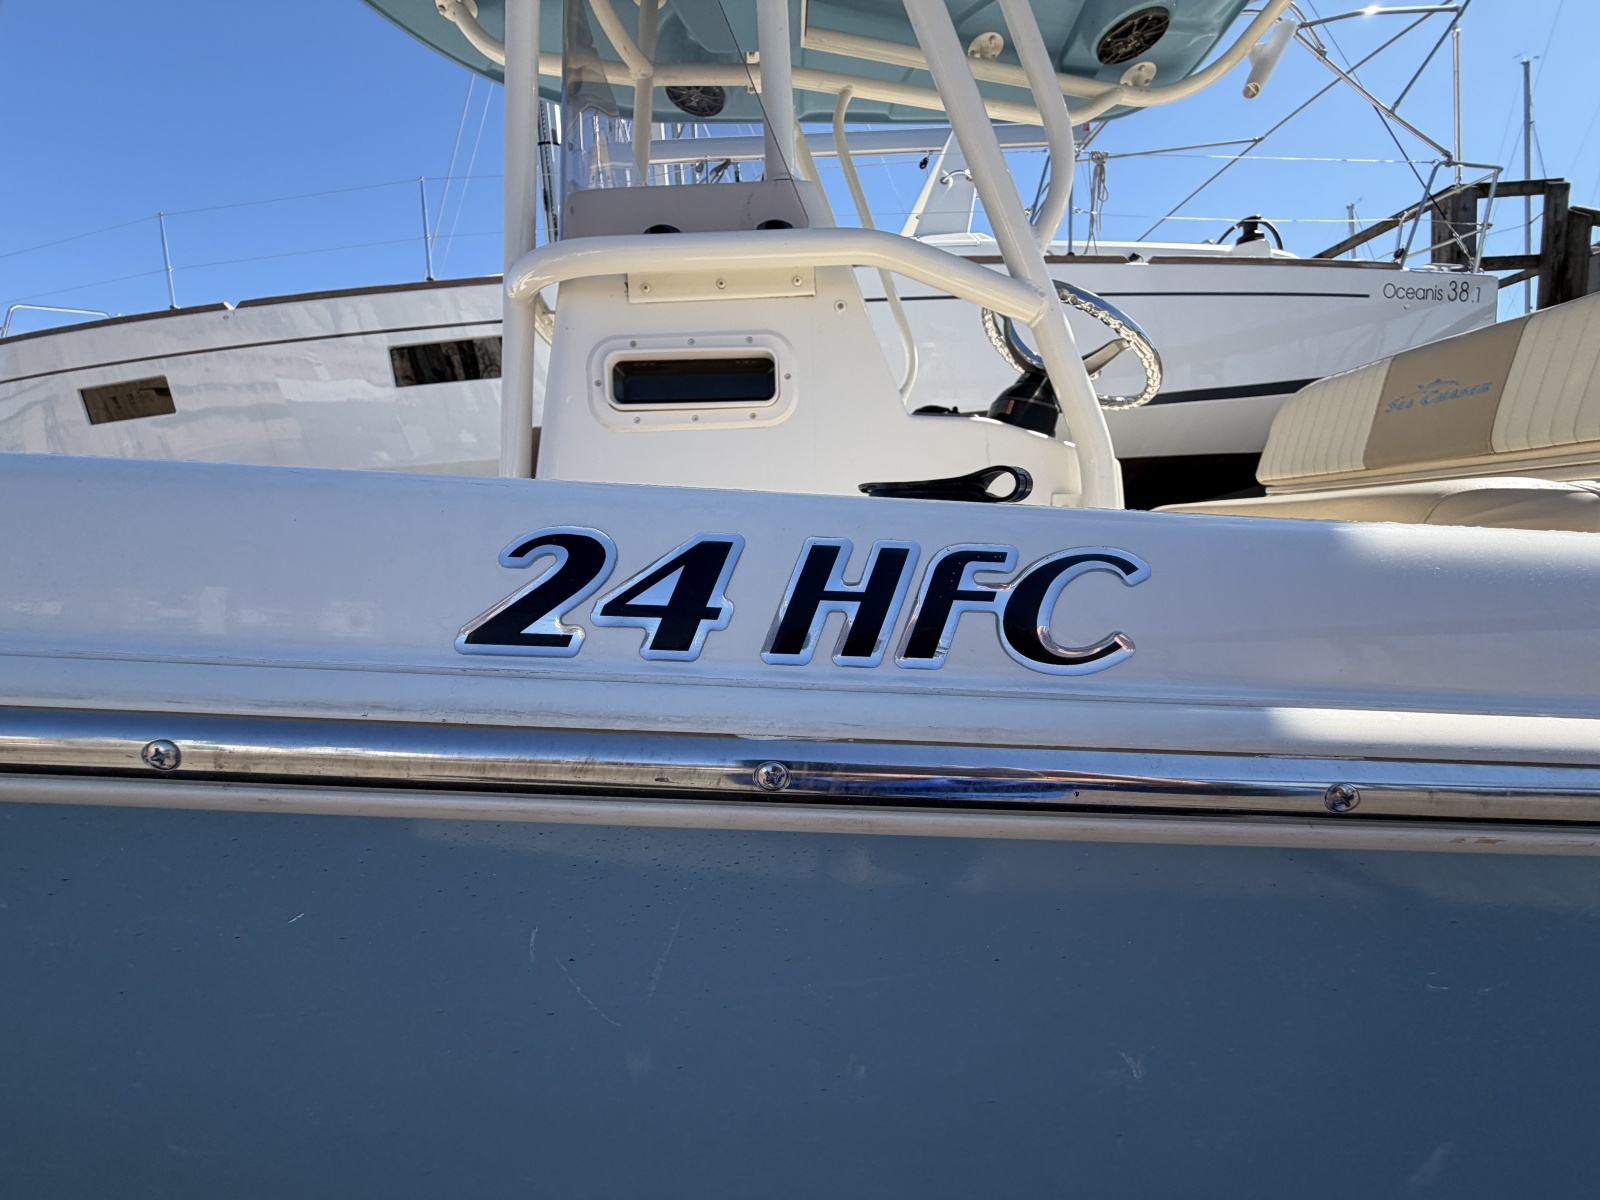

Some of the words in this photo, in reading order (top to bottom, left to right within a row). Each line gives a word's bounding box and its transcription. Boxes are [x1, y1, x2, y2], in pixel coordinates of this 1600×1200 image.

[1382, 282, 1443, 301] Oceanis
[1447, 280, 1482, 303] 38.1
[455, 526, 746, 661] 24
[761, 537, 1151, 675] HFC
